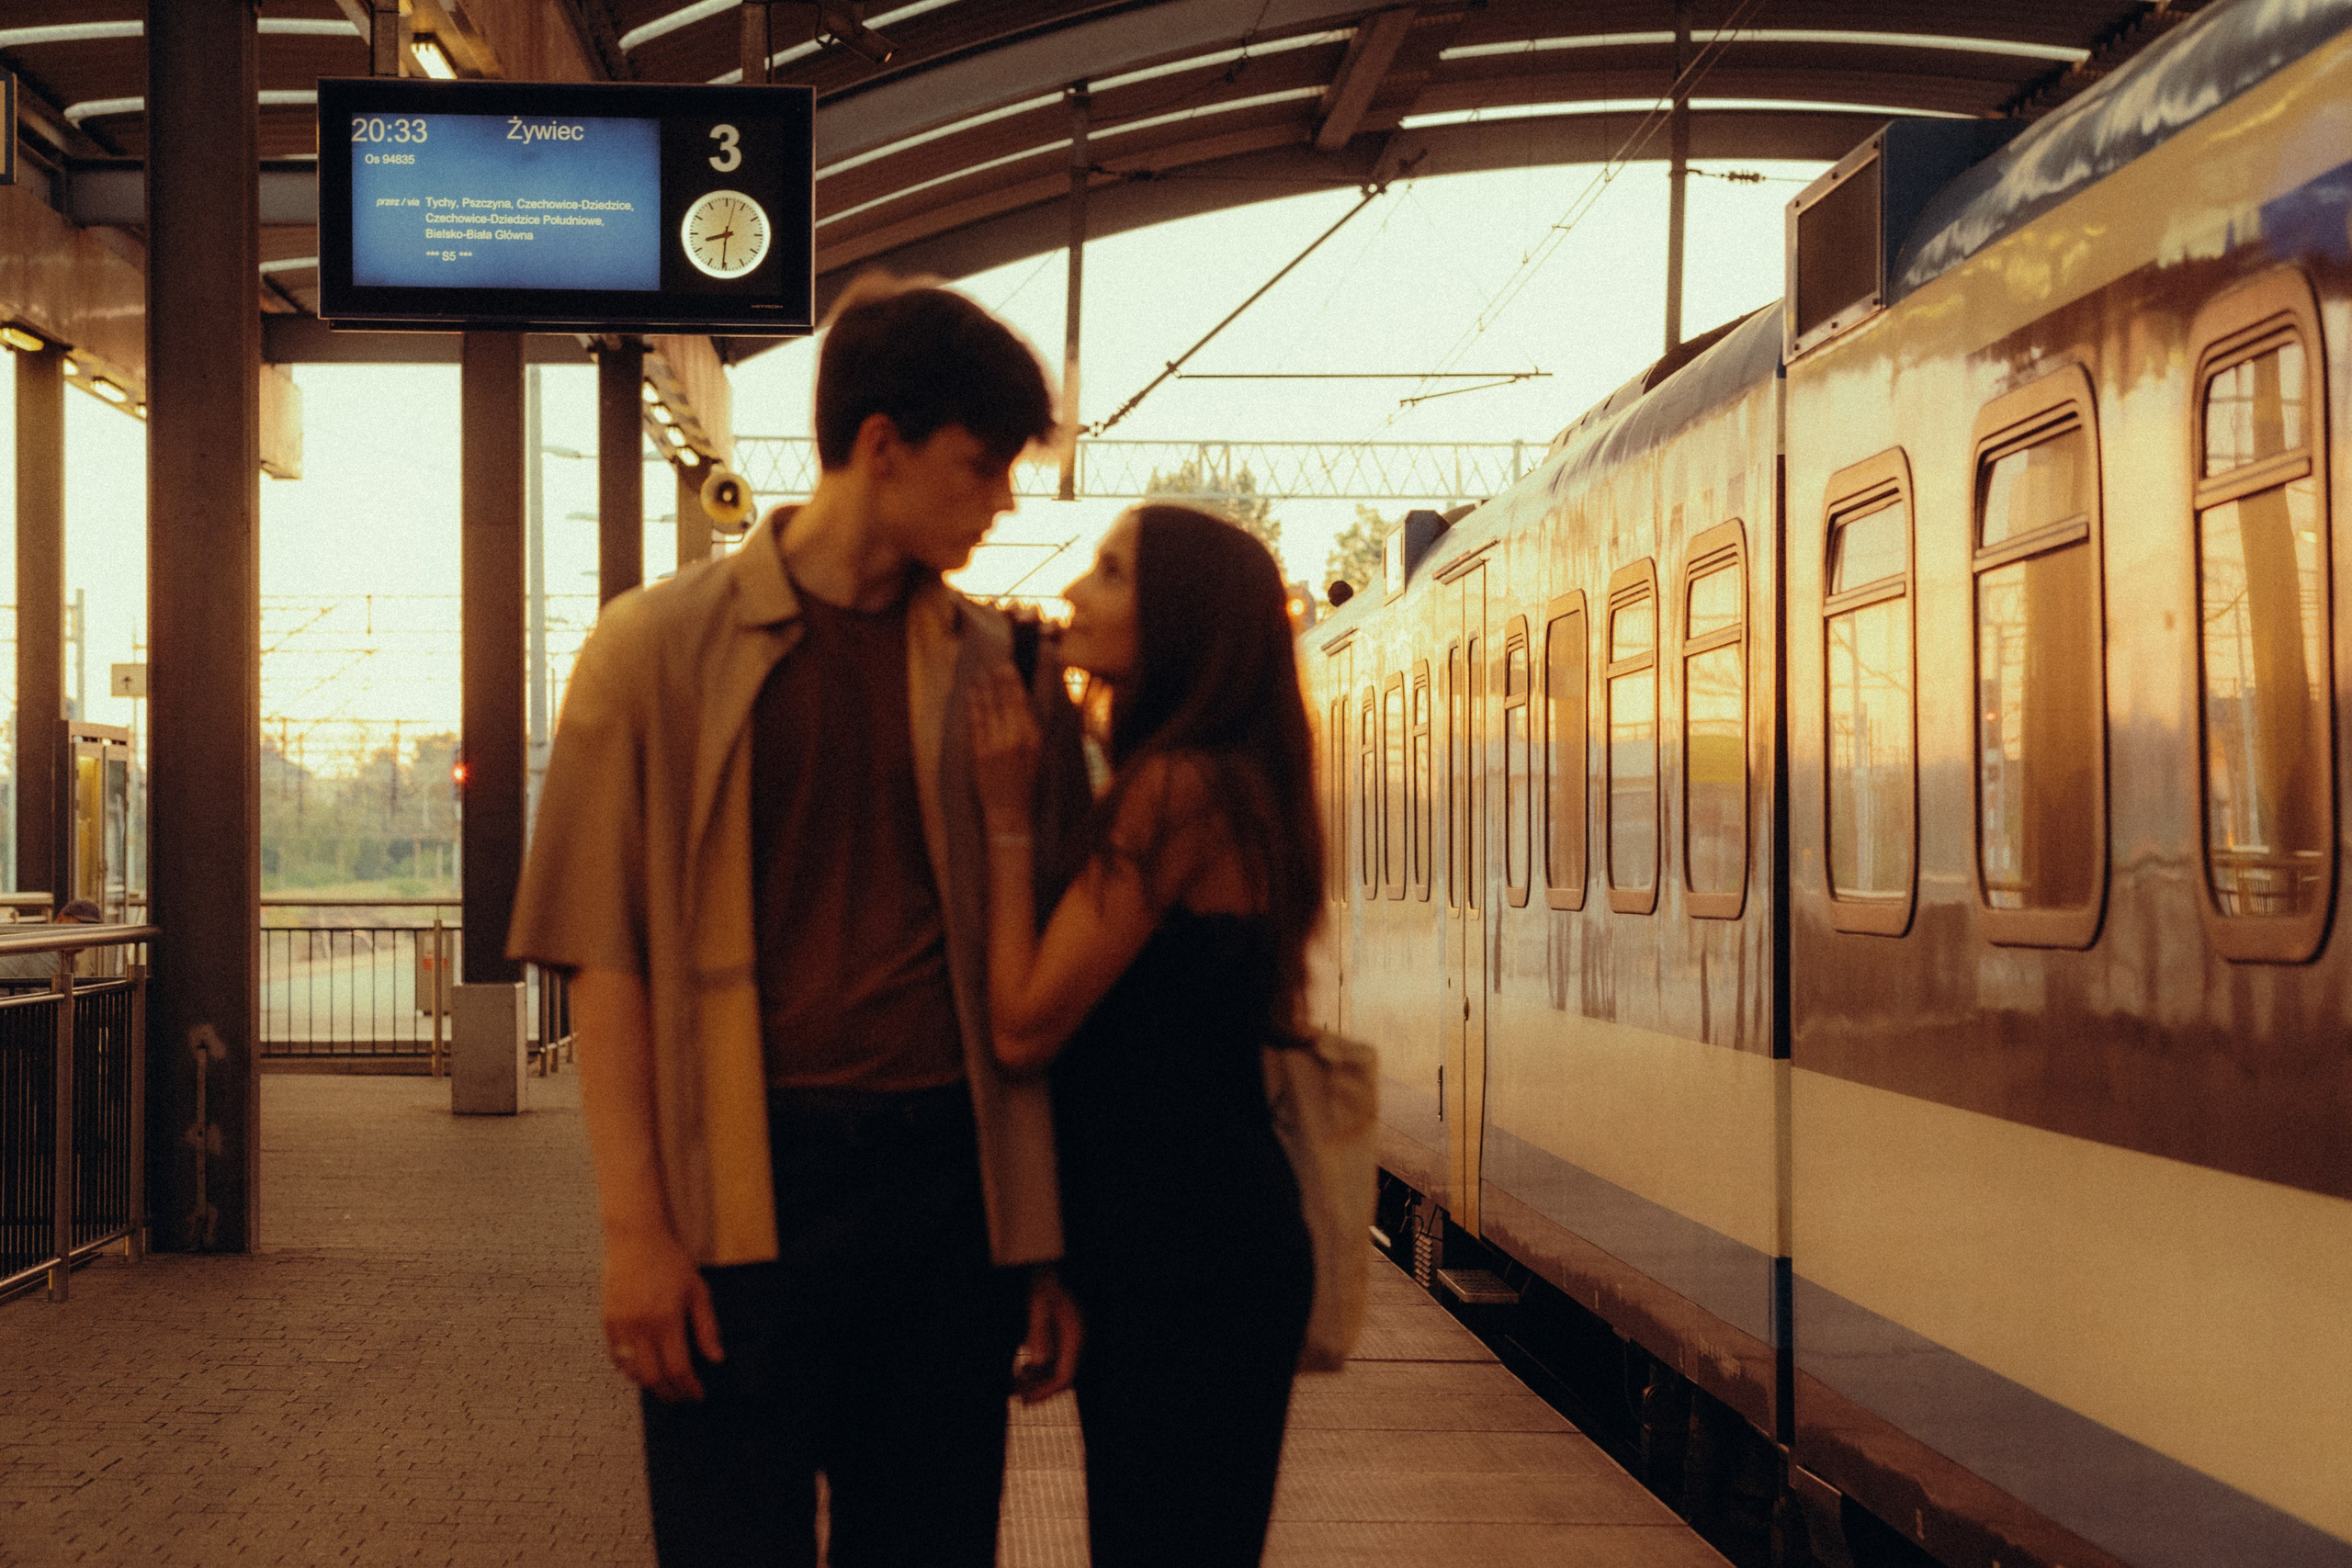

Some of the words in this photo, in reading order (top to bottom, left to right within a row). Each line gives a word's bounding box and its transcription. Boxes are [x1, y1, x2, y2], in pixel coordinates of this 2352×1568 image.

[351, 118, 428, 143] 20:33
[507, 115, 584, 145] Żywiec
[708, 123, 742, 173] 3
[365, 153, 380, 164] Os
[382, 154, 416, 164] 94835
[377, 197, 401, 208] przez
[407, 197, 421, 207] via
[425, 197, 459, 209] Tychy,
[462, 197, 514, 210] Pszczyna,
[516, 198, 634, 212] Czechowice-Dziedzice,
[425, 212, 540, 225] Czechowice-Dziedzice
[543, 214, 605, 228] Południowe,
[425, 229, 492, 240] Bielsko-Biała
[494, 230, 534, 241] Główna
[441, 251, 457, 262] S5
